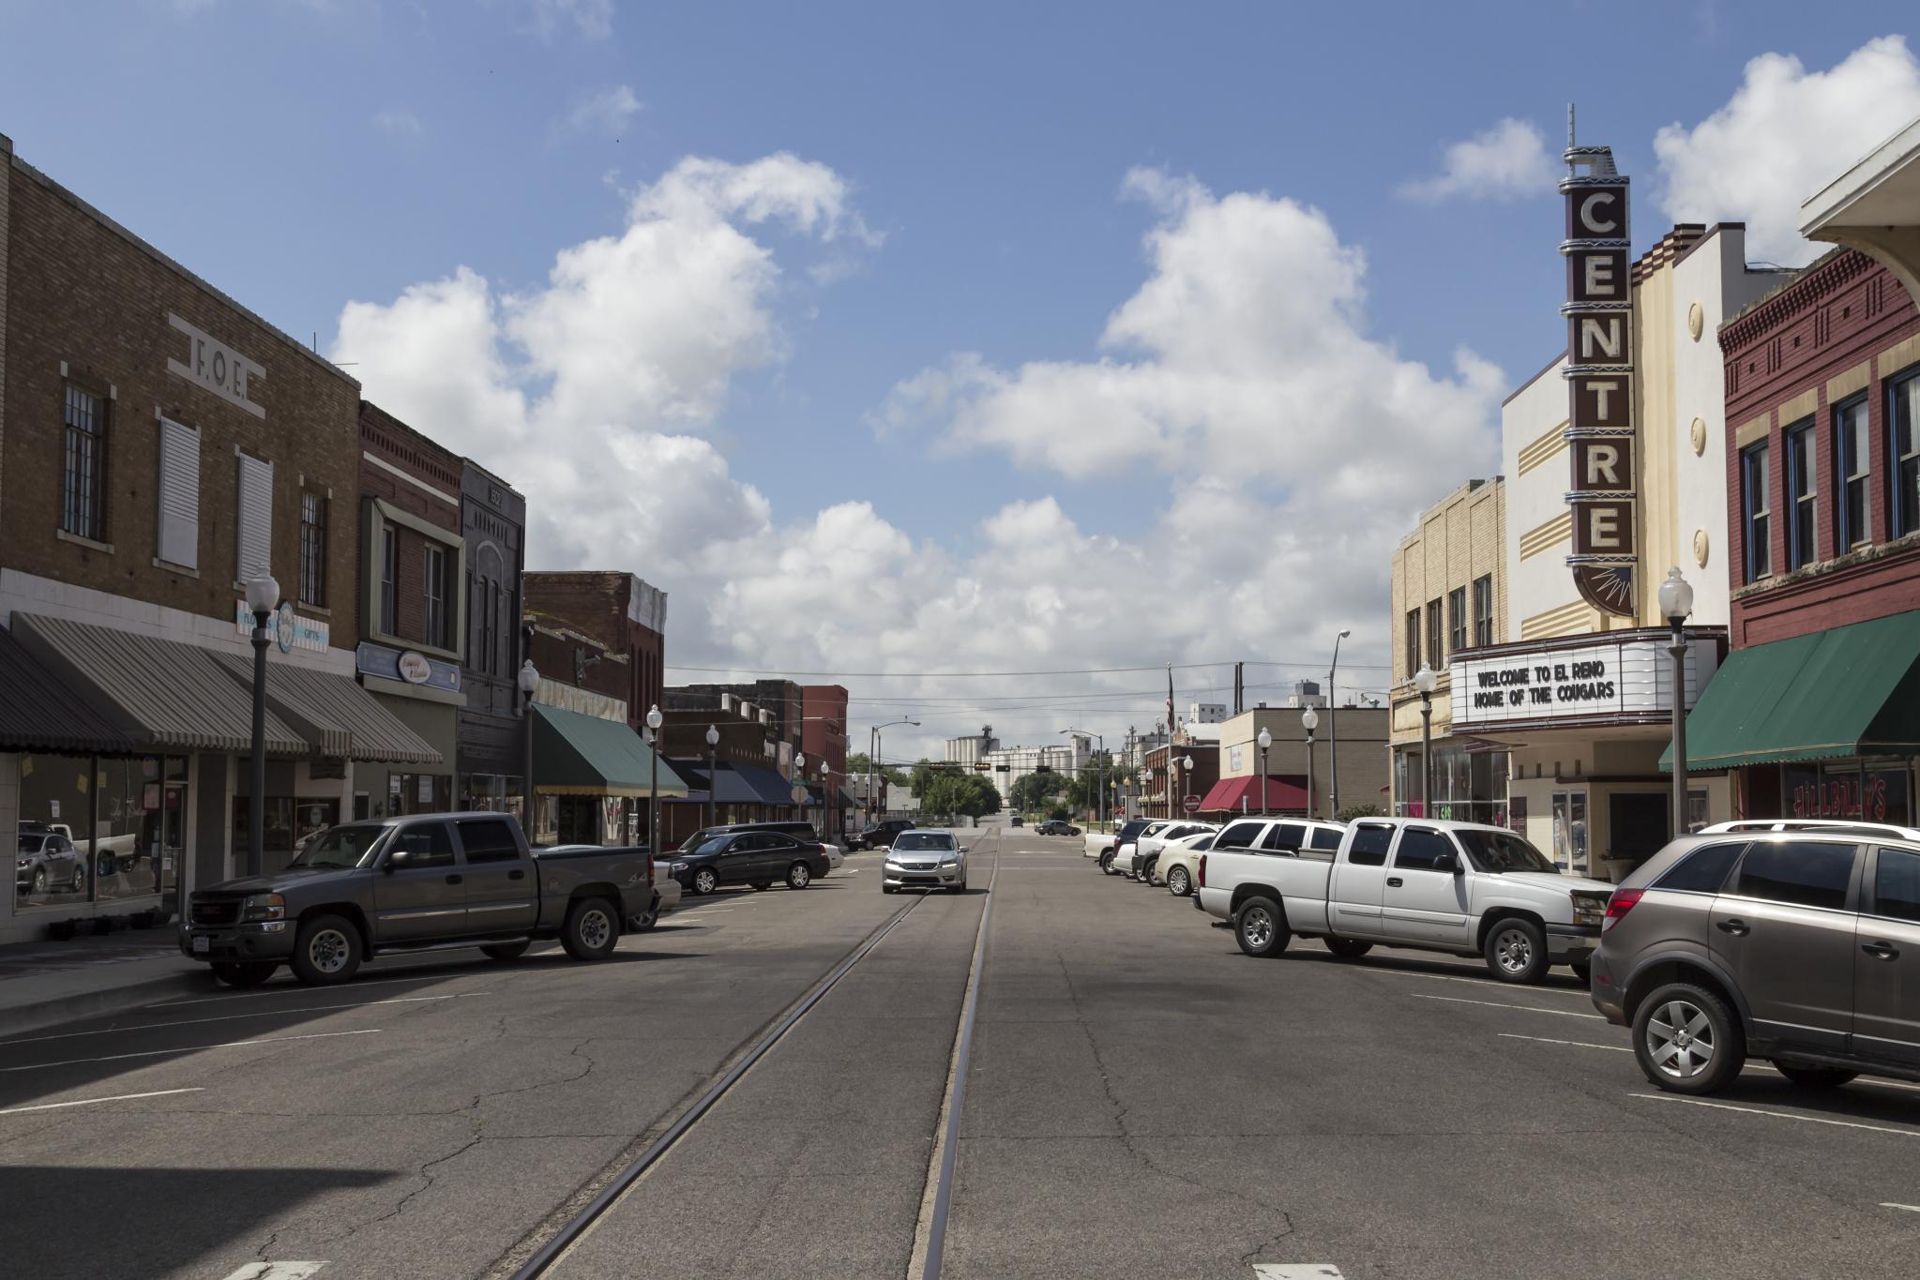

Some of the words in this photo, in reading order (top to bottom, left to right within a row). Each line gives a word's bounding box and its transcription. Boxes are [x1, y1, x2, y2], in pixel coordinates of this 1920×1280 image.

[197, 338, 245, 400] F.O.E.
[1581, 193, 1620, 547] CENTRE
[305, 628, 320, 641] GIFTS
[1477, 668, 1530, 689] WELCOME
[1535, 666, 1551, 683] TO
[1555, 664, 1569, 681] EL
[1573, 660, 1605, 680] RENO
[1474, 691, 1504, 709] HOME
[1509, 688, 1525, 706] OF
[1529, 687, 1552, 704] THE
[1557, 681, 1615, 702] COUGARS
